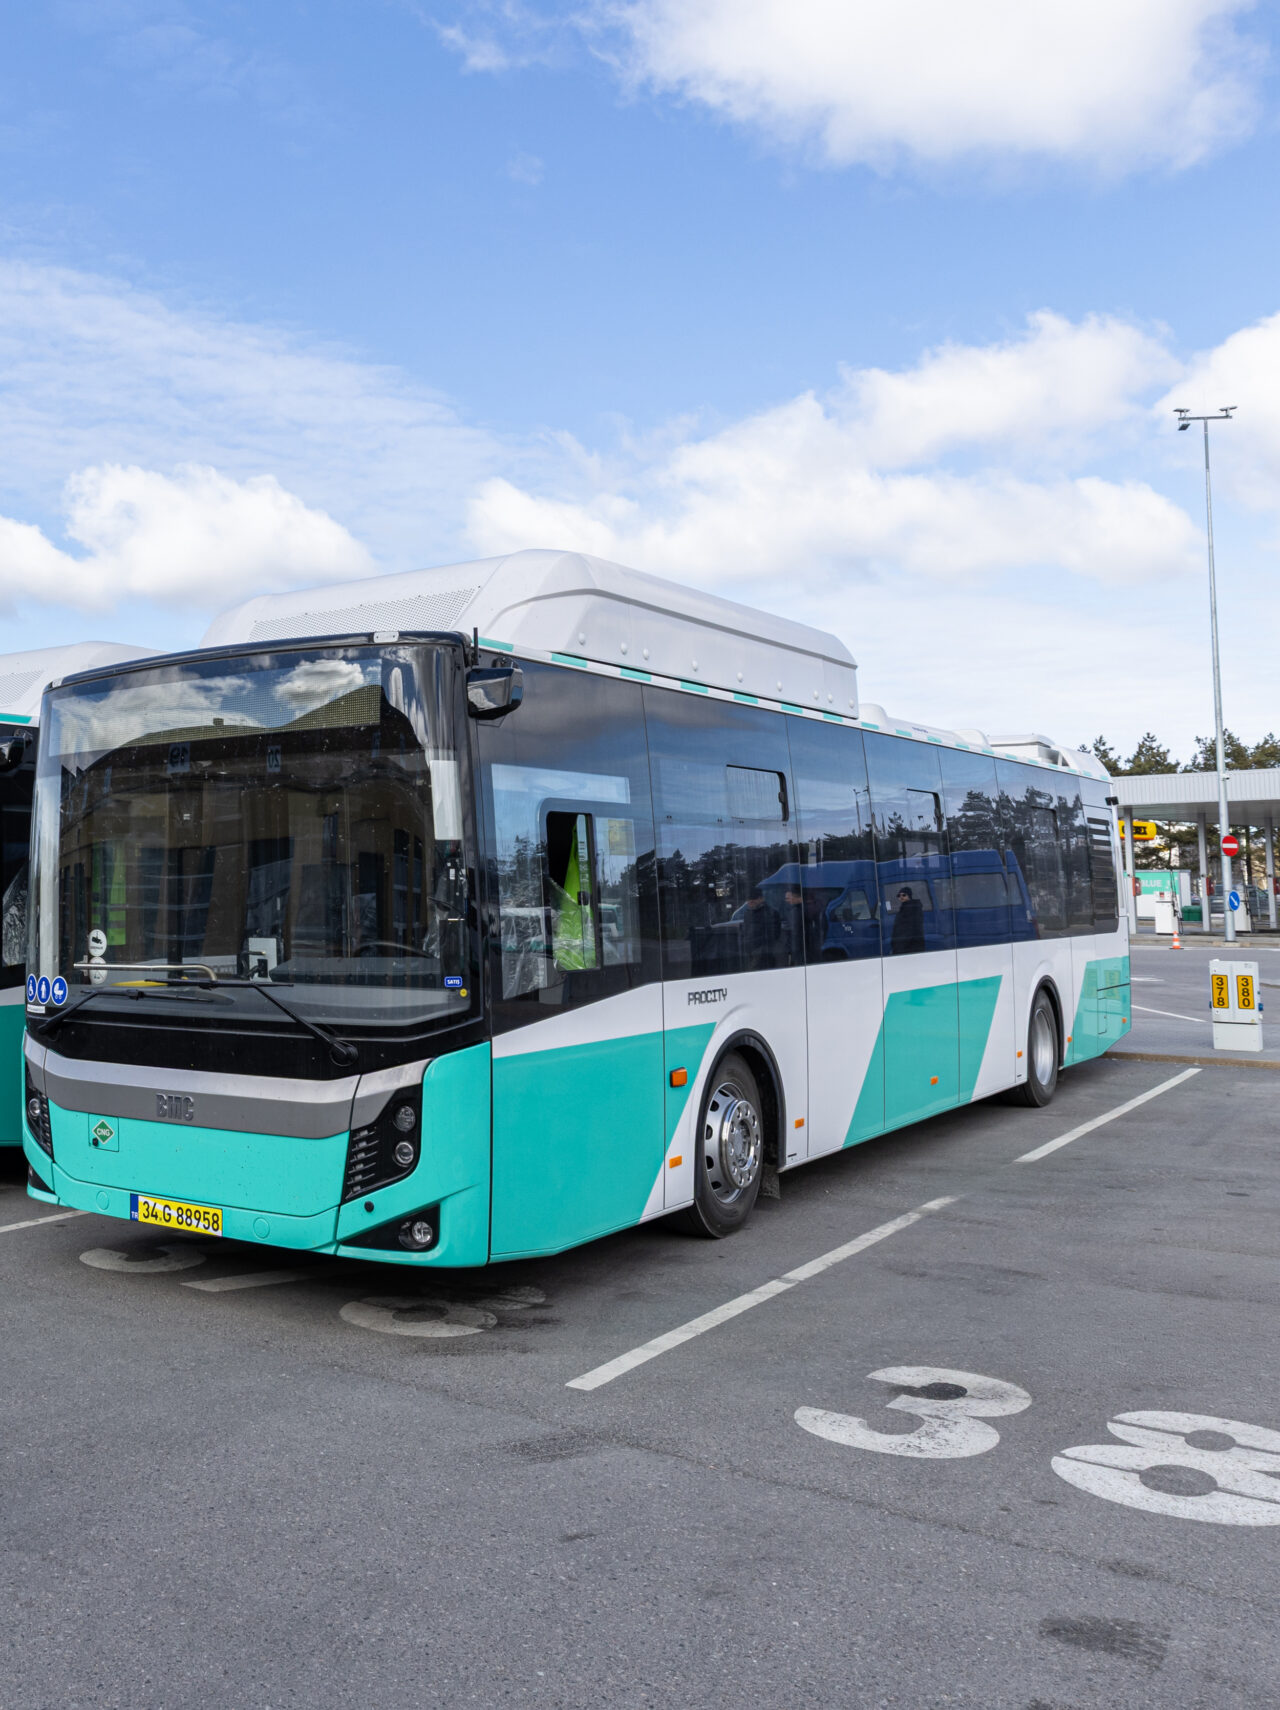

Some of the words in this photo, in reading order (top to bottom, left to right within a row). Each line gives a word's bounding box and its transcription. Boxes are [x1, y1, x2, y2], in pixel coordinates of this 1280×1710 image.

[688, 988, 728, 1006] PROCITY
[1216, 977, 1225, 1007] 378
[1241, 977, 1251, 1008] 380
[156, 1093, 195, 1121] BMC
[96, 1128, 110, 1137] CNG
[142, 1200, 158, 1221] 34
[162, 1204, 172, 1223] G
[176, 1206, 220, 1232] 88958
